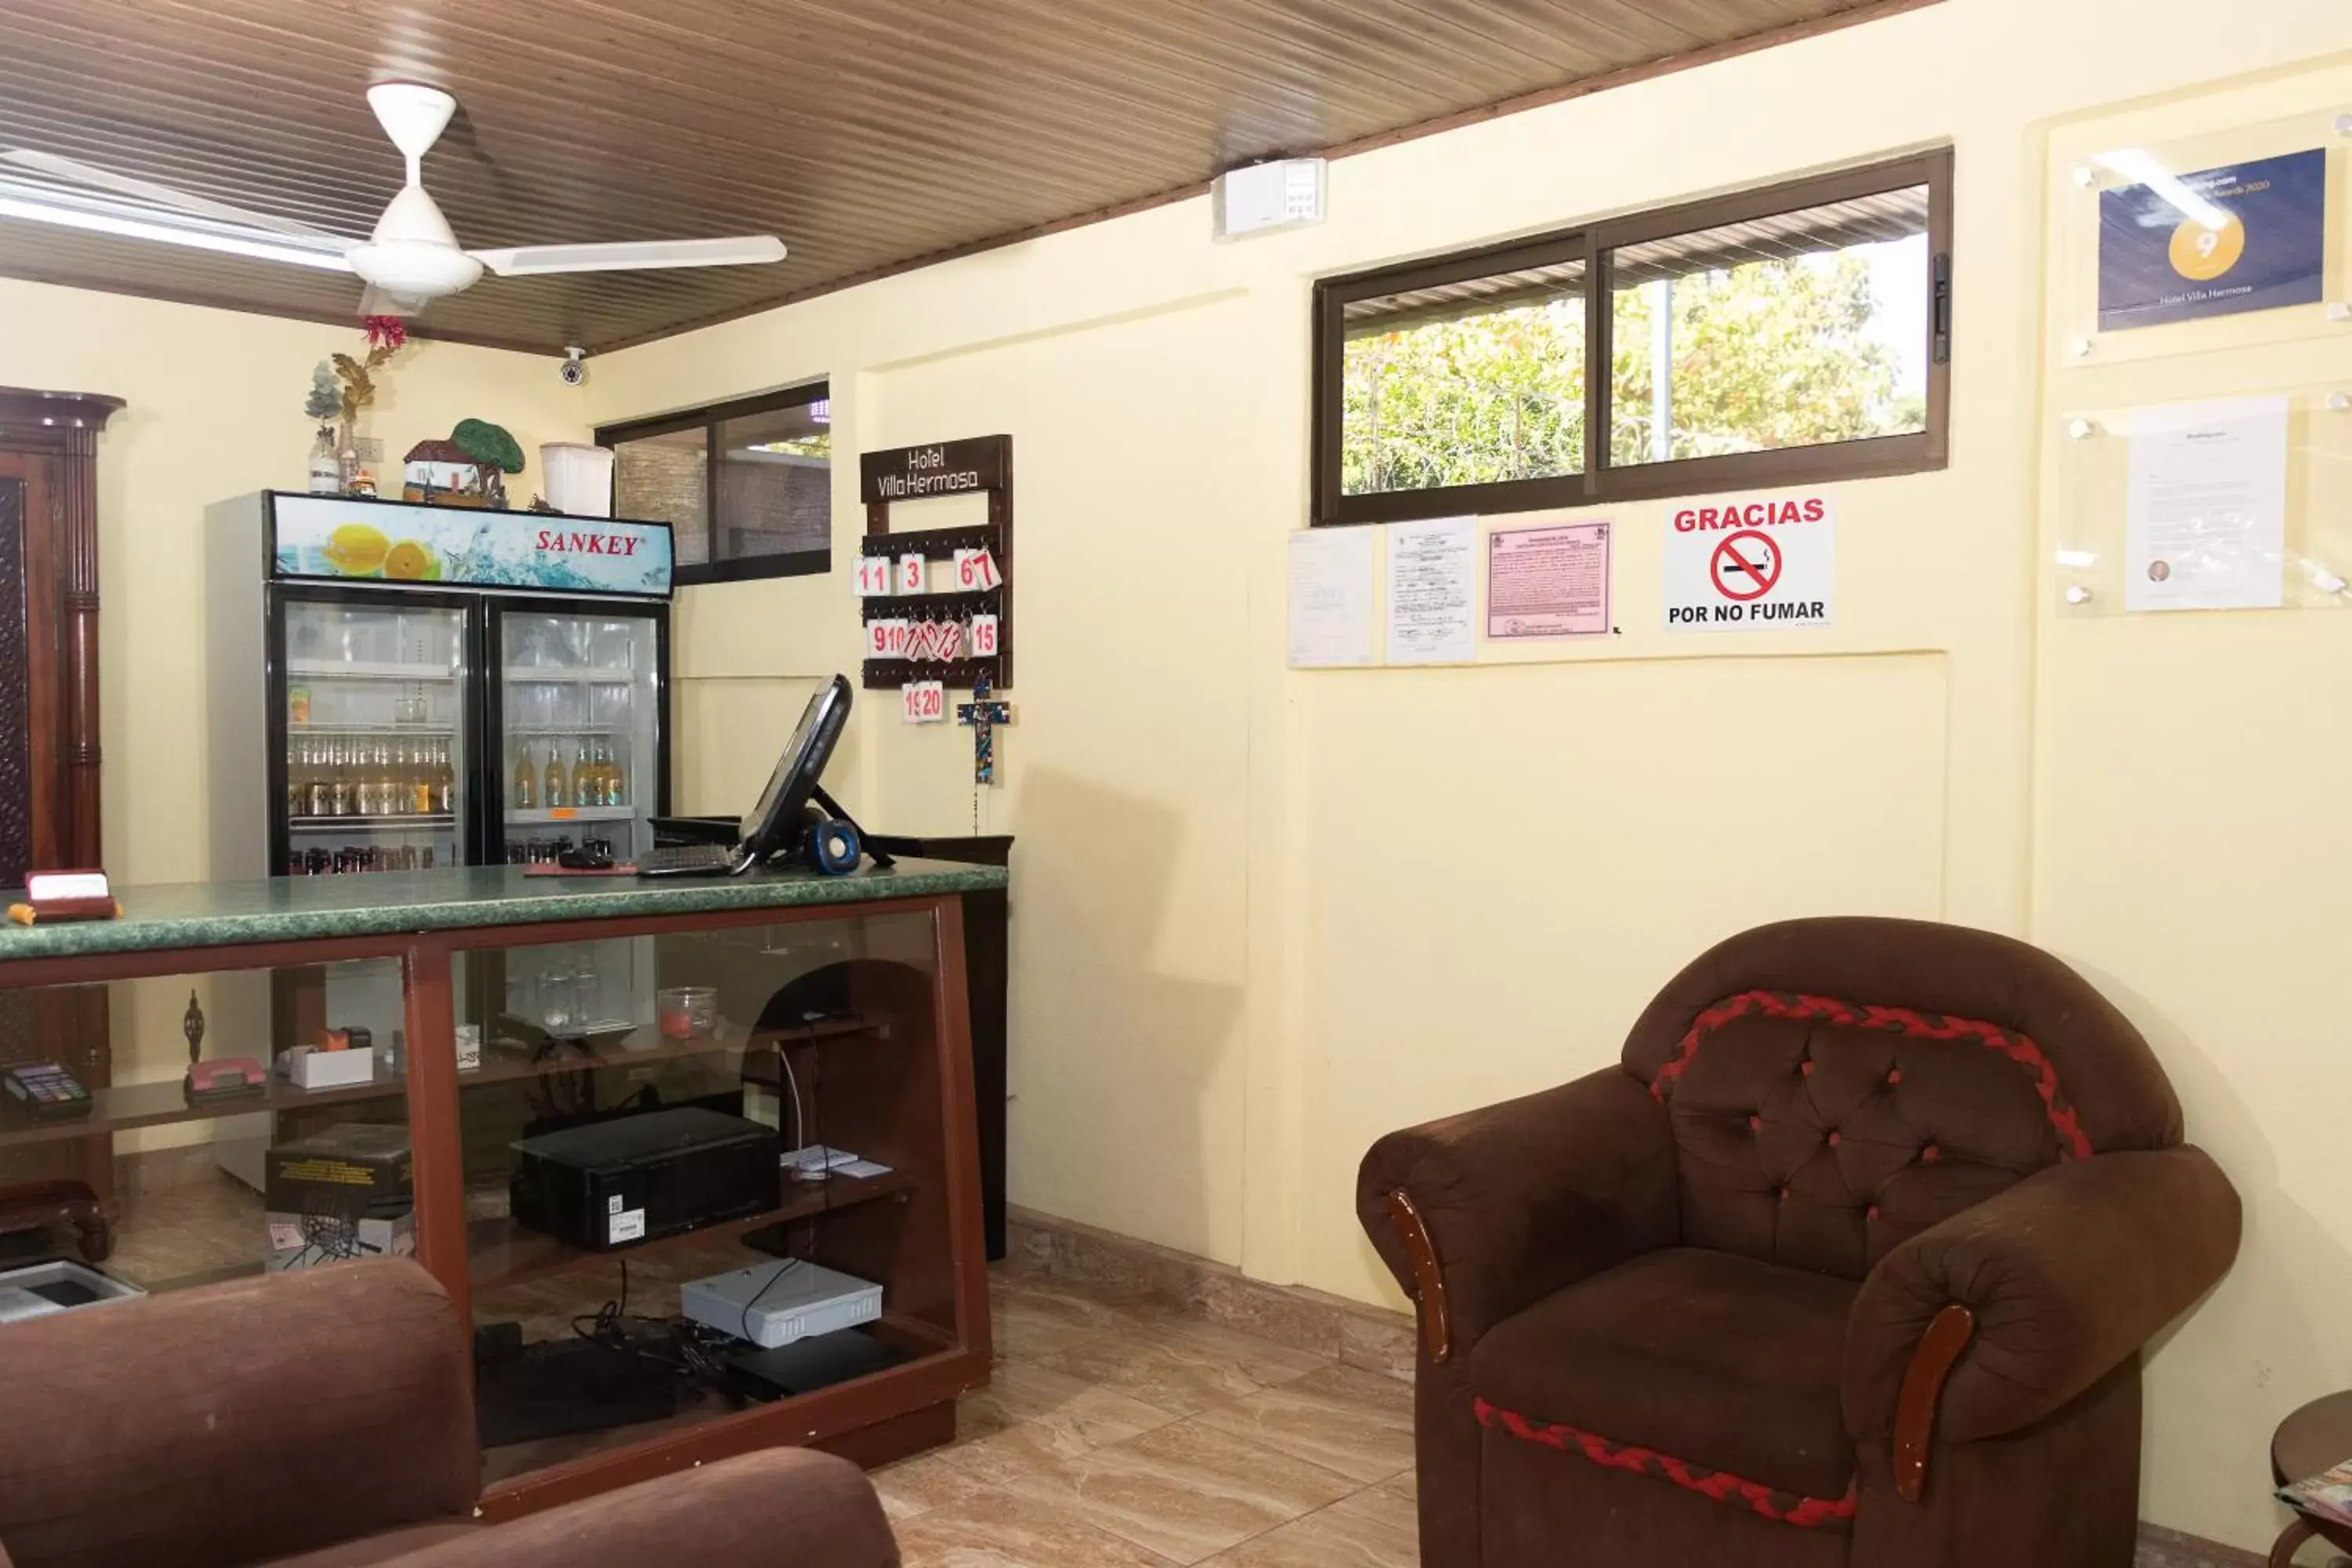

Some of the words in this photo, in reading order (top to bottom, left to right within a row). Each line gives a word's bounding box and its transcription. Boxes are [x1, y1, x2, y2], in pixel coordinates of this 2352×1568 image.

[2196, 231, 2217, 258] 9
[2160, 293, 2185, 306] Hotel
[2186, 290, 2207, 301] Villa
[2209, 285, 2252, 299] Hermosa
[909, 446, 945, 470] Hotel
[877, 474, 906, 497] Villa
[907, 470, 978, 495] Hermosa
[1674, 498, 1824, 532] GRACIAS
[535, 531, 638, 555] SANKEY
[907, 561, 919, 588] 3
[971, 551, 993, 586] 7
[1669, 606, 1708, 623] POR
[1715, 604, 1743, 622] NO
[1750, 601, 1825, 620] FUMAR
[937, 625, 960, 657] 13
[975, 624, 994, 650] 15
[923, 689, 940, 714] 20
